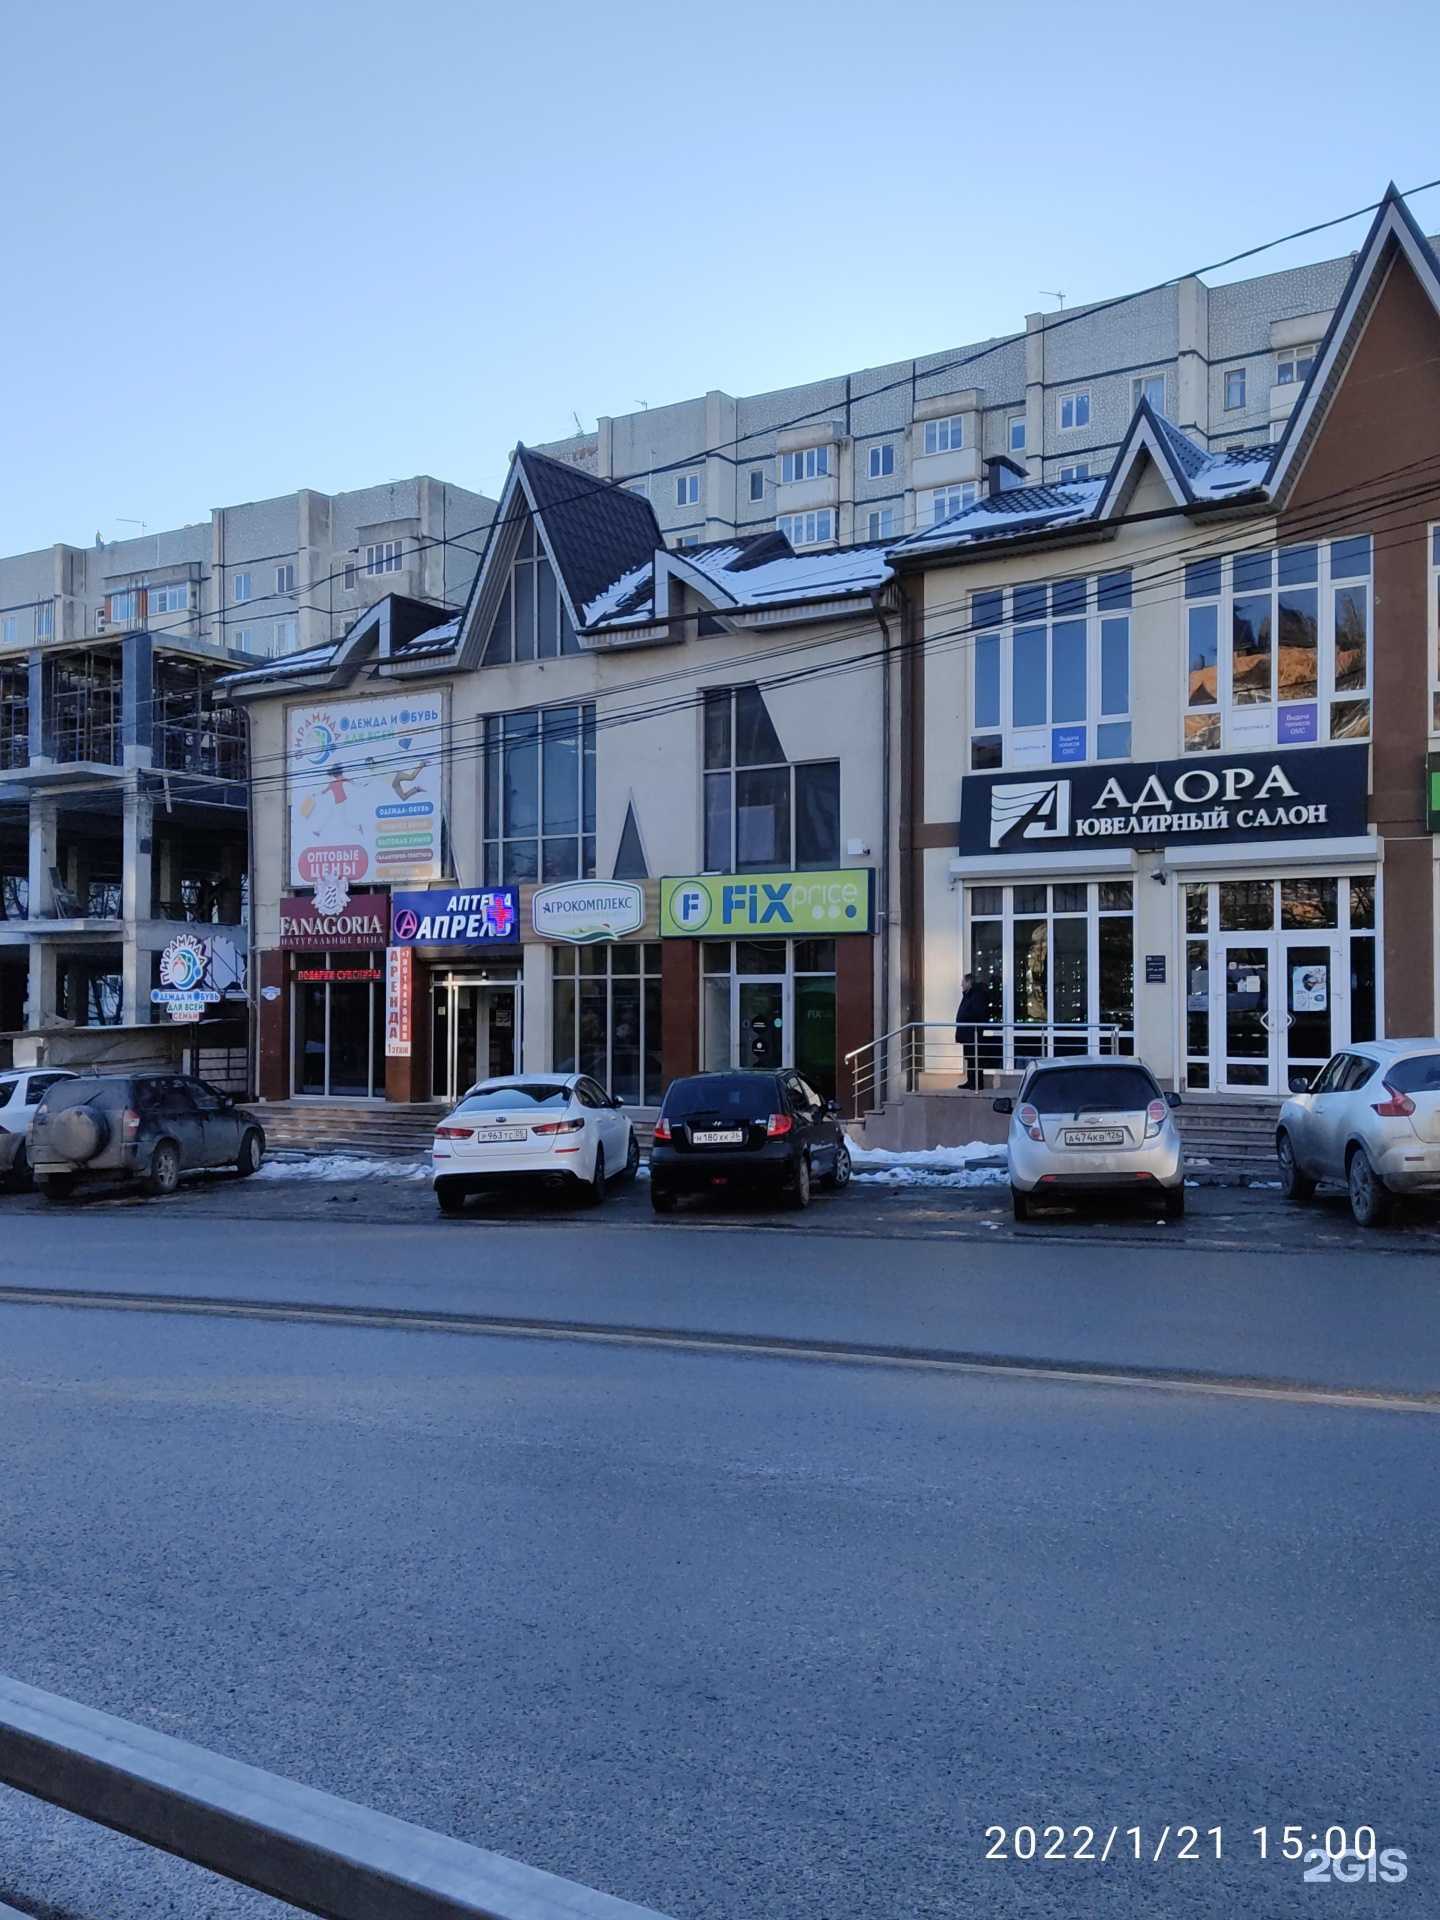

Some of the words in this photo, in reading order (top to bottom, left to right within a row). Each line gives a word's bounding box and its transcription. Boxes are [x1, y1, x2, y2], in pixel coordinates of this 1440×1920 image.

[391, 715, 398, 725] И
[1091, 764, 1300, 814] АДОРА
[1075, 805, 1230, 837] ЮВЕЛИРНЫЙ
[1236, 803, 1328, 829] САЛОН
[307, 849, 360, 863] ОПТОВЫЕ
[311, 862, 356, 878] ЦЕНЫ
[446, 893, 512, 912] АПТЕА
[543, 896, 633, 914] АГРОКОМПЛЕКС
[793, 882, 858, 911] price
[280, 914, 383, 936] FANAGORIA
[356, 935, 385, 945] ВИНА
[160, 934, 208, 986] ПИРАМИДА
[389, 950, 399, 1039] АРЕНДА
[168, 1002, 183, 1011] ДЛЯ
